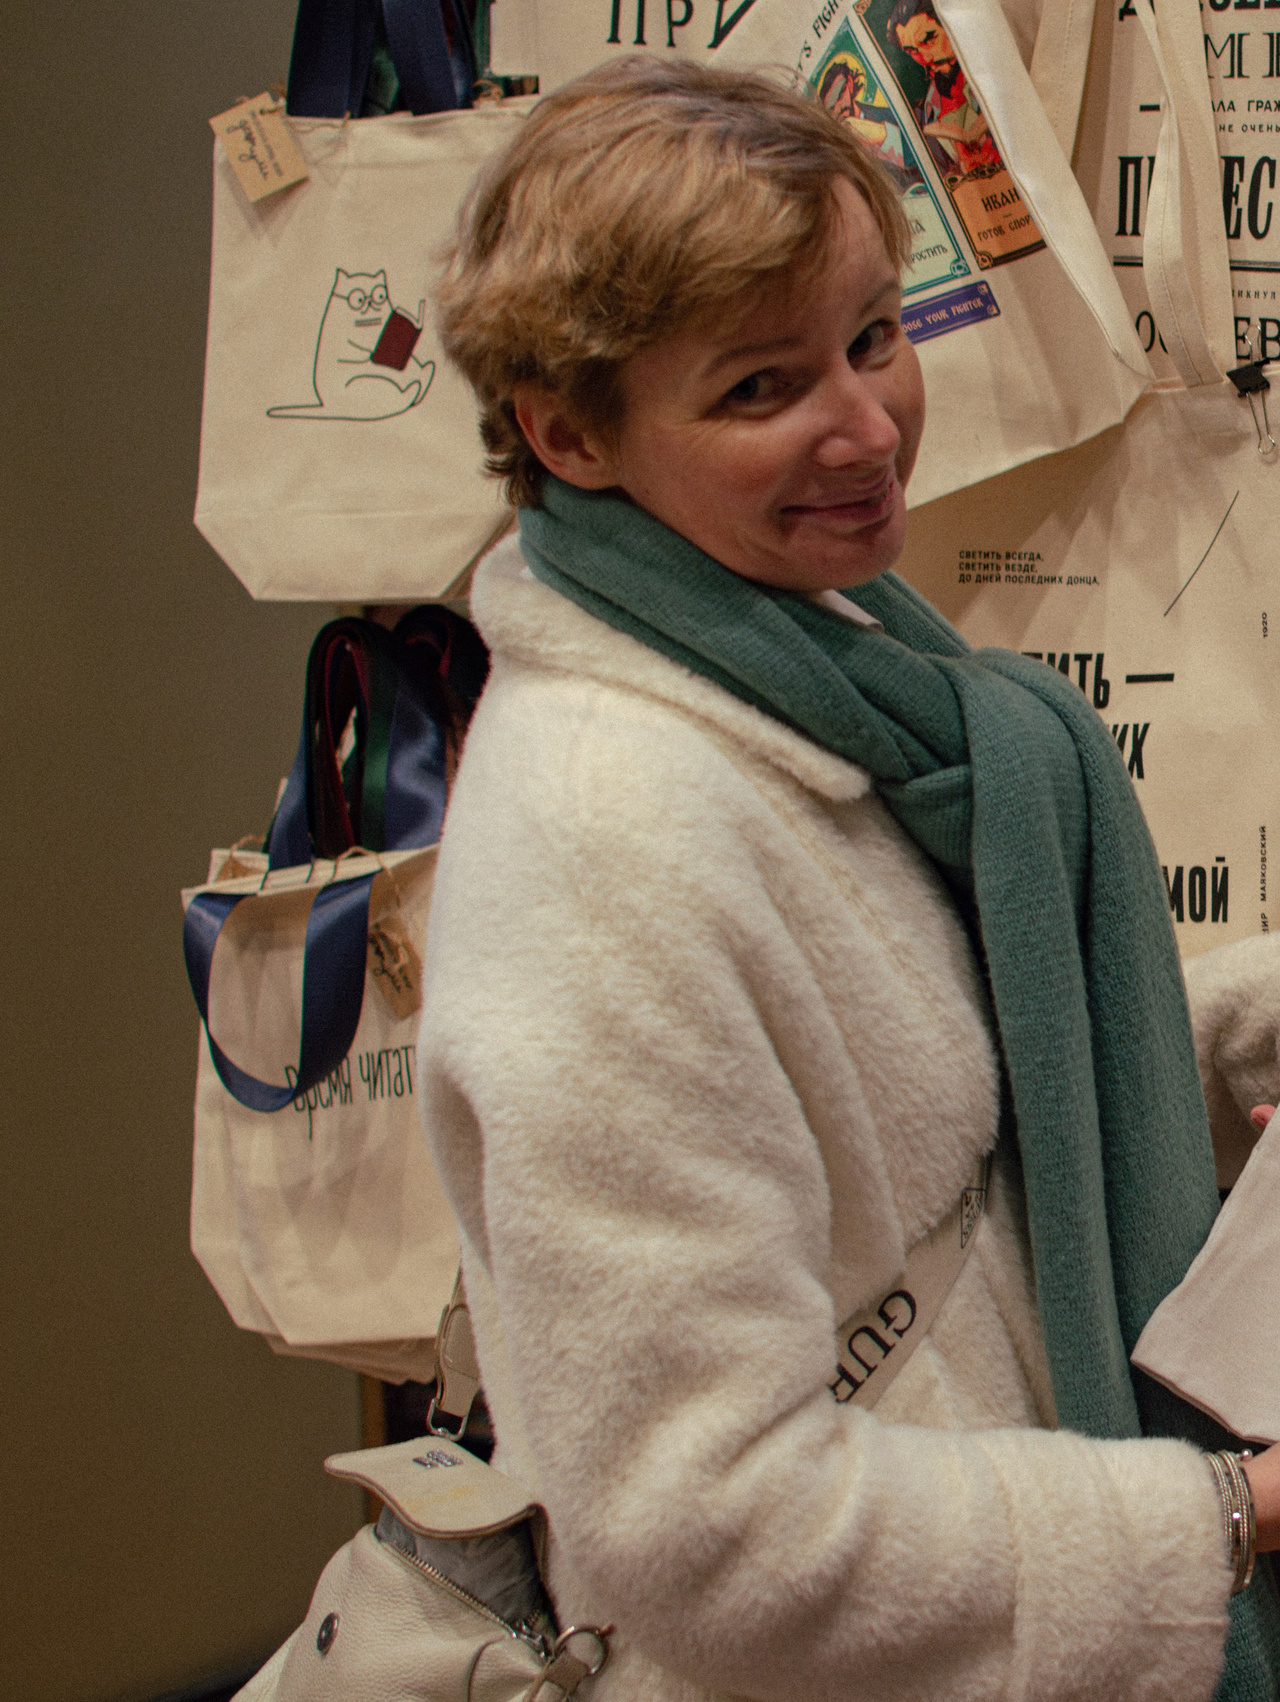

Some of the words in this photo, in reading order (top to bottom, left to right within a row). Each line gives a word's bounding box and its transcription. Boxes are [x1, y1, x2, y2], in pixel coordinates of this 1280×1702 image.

[812, 0, 839, 39] FIGH
[1241, 123, 1280, 133] ОЧЕНЬ
[1008, 214, 1031, 232] СПОР
[901, 321, 923, 334] OOSE
[959, 550, 1001, 560] СВЕТИТЬ
[1005, 552, 1044, 562] ВСЕГДА,
[959, 562, 1001, 572] СВЕТИТЬ
[1005, 563, 1038, 573] ВЕЗДЕ,
[958, 574, 972, 583] ДО
[975, 573, 1001, 584] ДНЕЙ
[1005, 574, 1063, 585] ПОСЛЕДНИХ
[1066, 575, 1100, 586] ДОНЦА,
[1259, 825, 1267, 902] МАЯКОВСКИЙ
[827, 1288, 917, 1405] GUE
